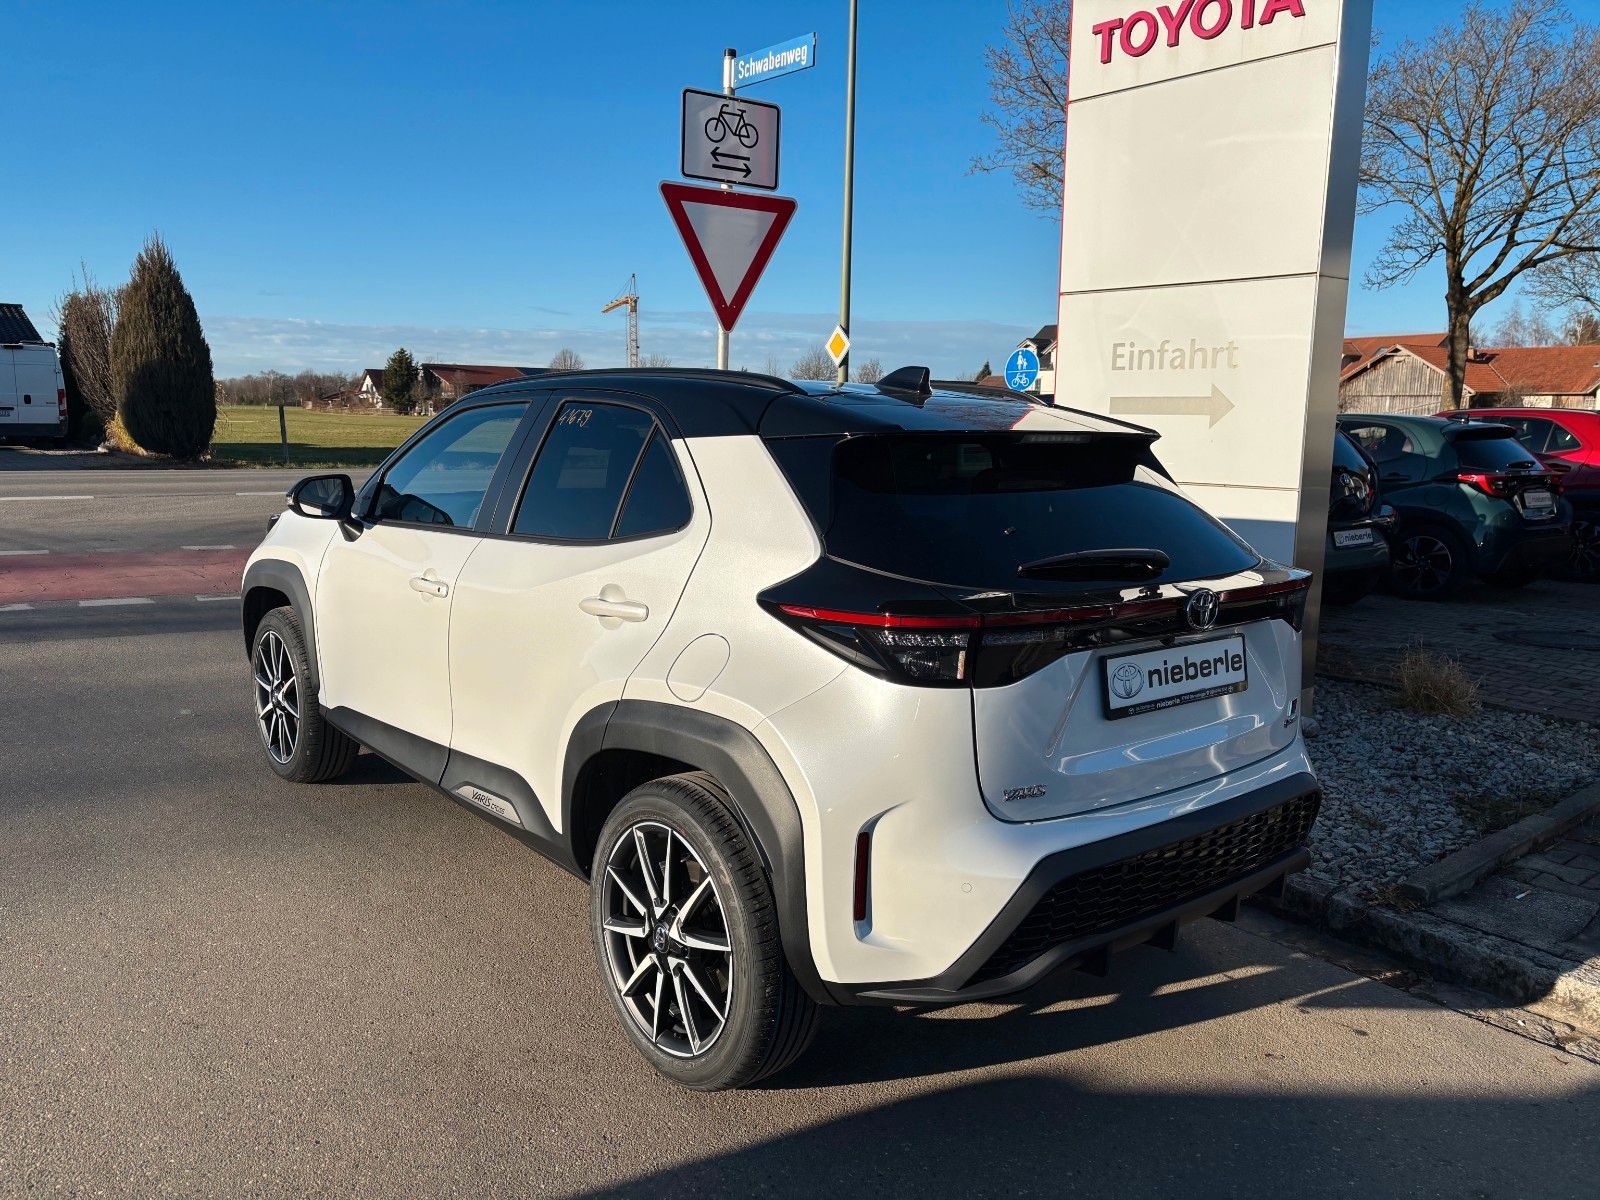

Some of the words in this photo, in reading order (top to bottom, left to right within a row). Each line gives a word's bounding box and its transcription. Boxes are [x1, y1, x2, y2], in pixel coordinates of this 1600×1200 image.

[738, 44, 808, 79] Schwabenweg
[1111, 338, 1240, 371] Einfahrt
[1147, 649, 1243, 688] nieberle
[471, 789, 492, 807] YARIS
